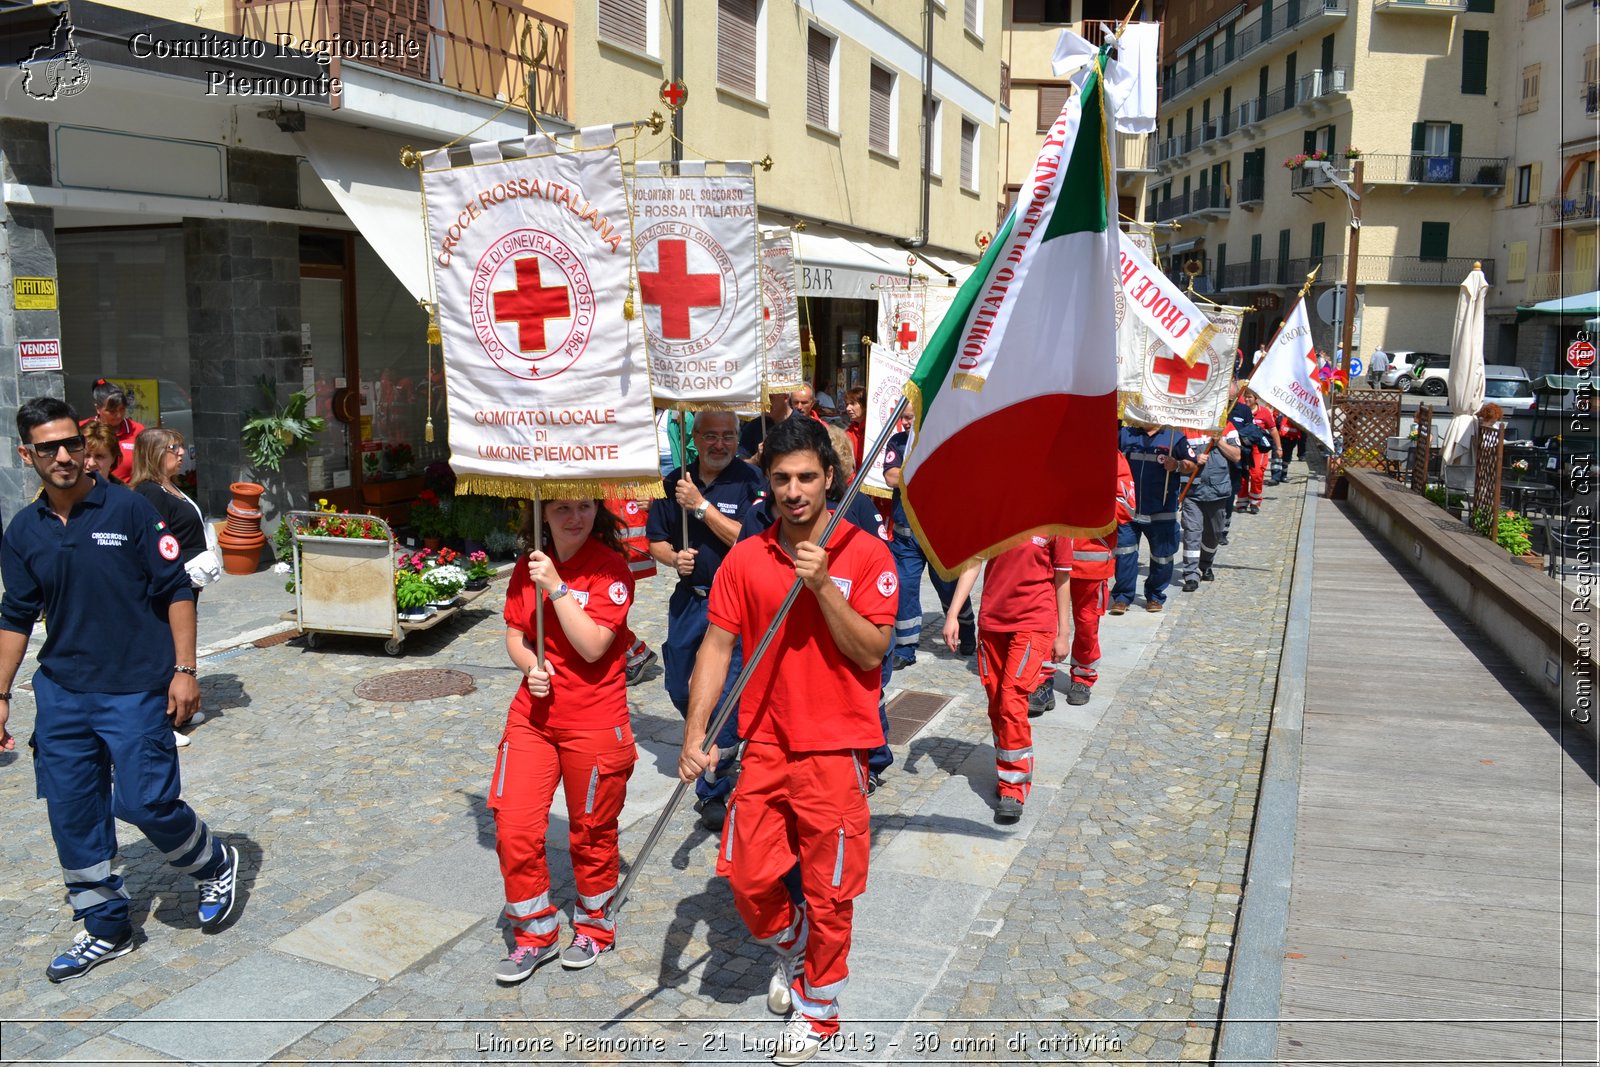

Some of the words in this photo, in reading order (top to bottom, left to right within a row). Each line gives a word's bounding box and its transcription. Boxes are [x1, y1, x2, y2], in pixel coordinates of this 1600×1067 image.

[679, 188, 696, 201] DEL
[700, 188, 743, 201] SOCCORSO
[644, 204, 688, 218] ROSSA
[691, 204, 754, 218] ITALIANA
[438, 200, 482, 268] CROCE
[478, 178, 544, 211] ROSSA
[545, 181, 622, 255] ITALIANA
[502, 234, 552, 254] GINEVRA
[680, 225, 692, 237] DI
[694, 231, 732, 275] GINEVRA
[489, 247, 504, 265] DI
[553, 246, 570, 265] 22
[957, 267, 1015, 370] COMITATO
[1007, 242, 1024, 264] DI
[1018, 153, 1061, 239] LIMONE
[16, 279, 54, 295] AFFITTASI
[802, 267, 833, 290] BAR
[567, 262, 592, 327] AGOSTO
[473, 259, 505, 361] CONVENZIONE
[1129, 275, 1191, 339] CROCE
[20, 342, 58, 355] VENDESI
[564, 329, 586, 358] 1864
[1569, 350, 1594, 360] STOP
[724, 360, 741, 372] DI
[1288, 380, 1320, 408] SERVIR
[1270, 385, 1321, 427] SECOURISME
[474, 409, 548, 427] COMITATO
[549, 408, 617, 426] LOCALE
[535, 430, 548, 442] DI
[477, 444, 536, 461] LIMONE
[533, 445, 619, 461] PIEMONTE
